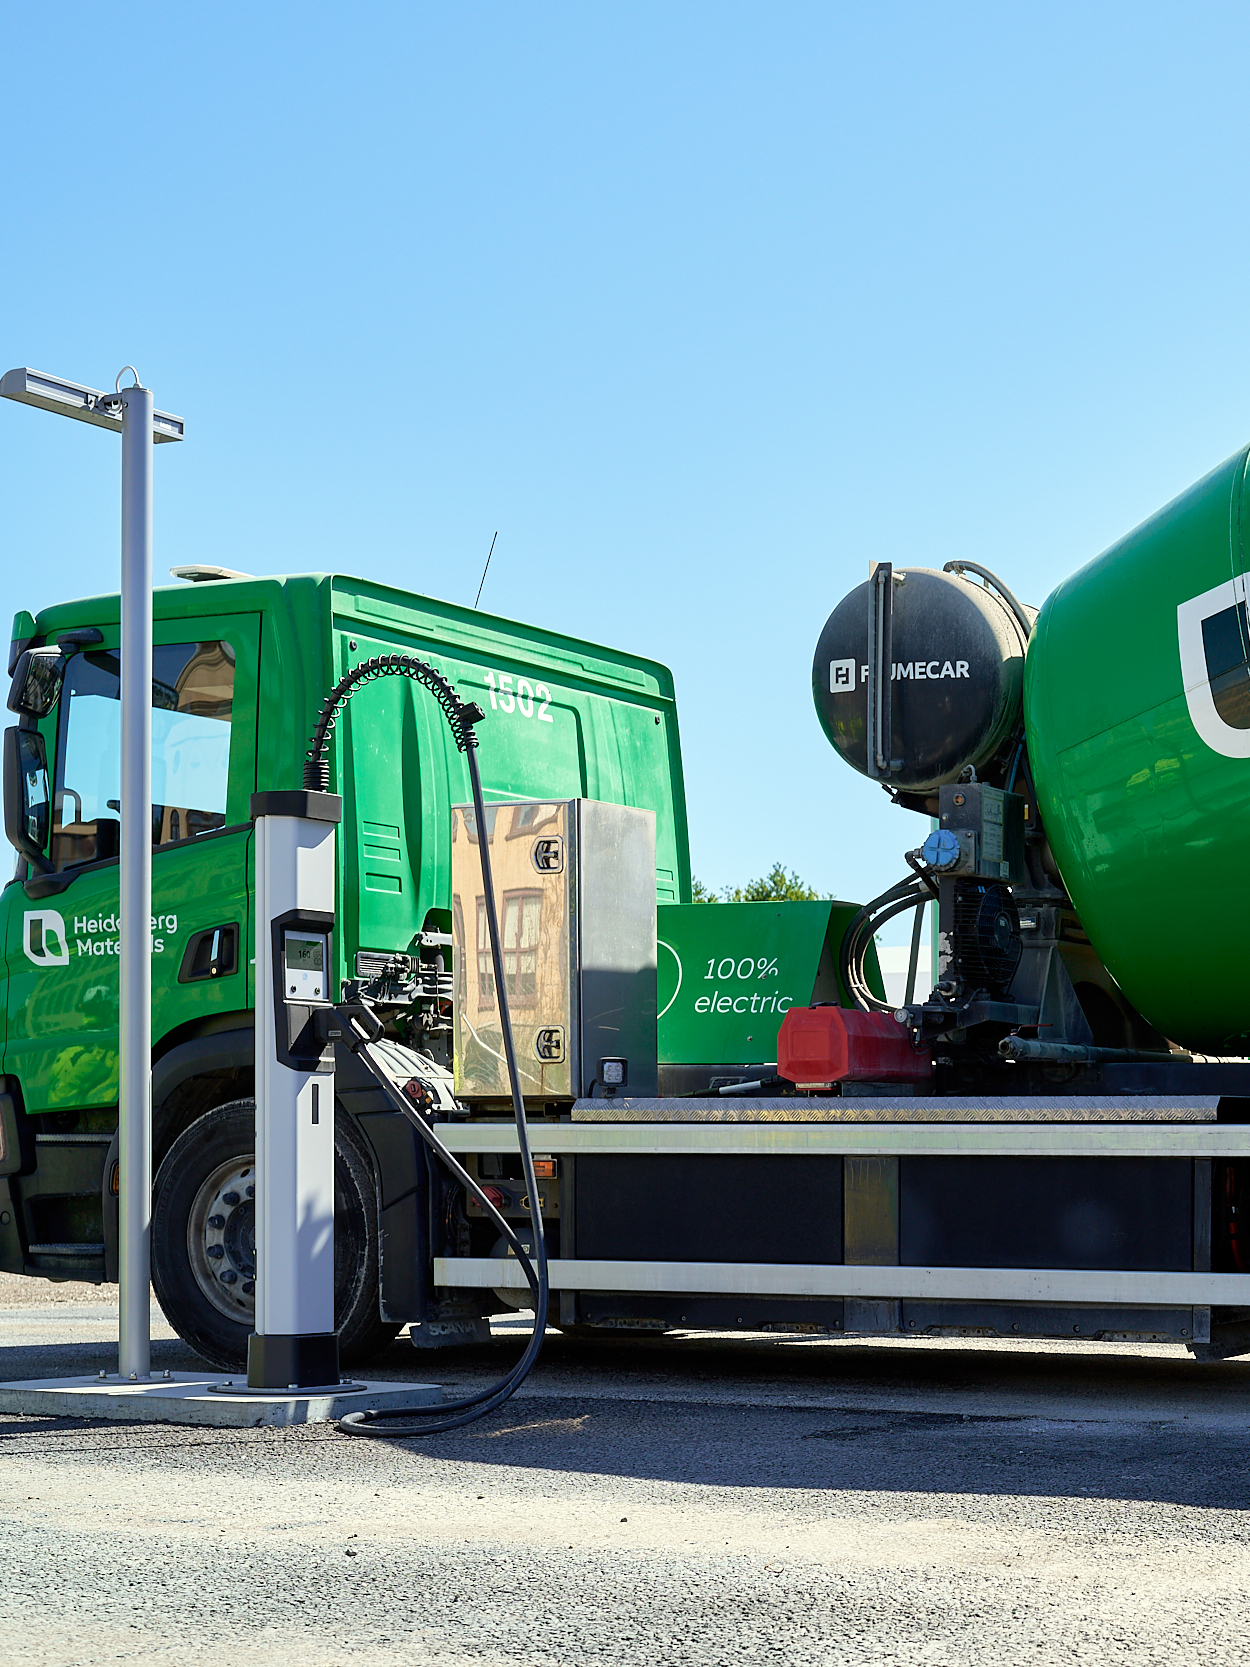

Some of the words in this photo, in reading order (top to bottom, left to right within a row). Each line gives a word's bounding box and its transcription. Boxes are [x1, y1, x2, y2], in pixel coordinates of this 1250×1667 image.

[860, 660, 970, 683] FMECAR
[483, 671, 554, 723] 1502
[74, 912, 178, 934] Heiderg
[76, 934, 165, 957] Matels
[703, 957, 778, 980] 100%
[694, 990, 793, 1014] electric
